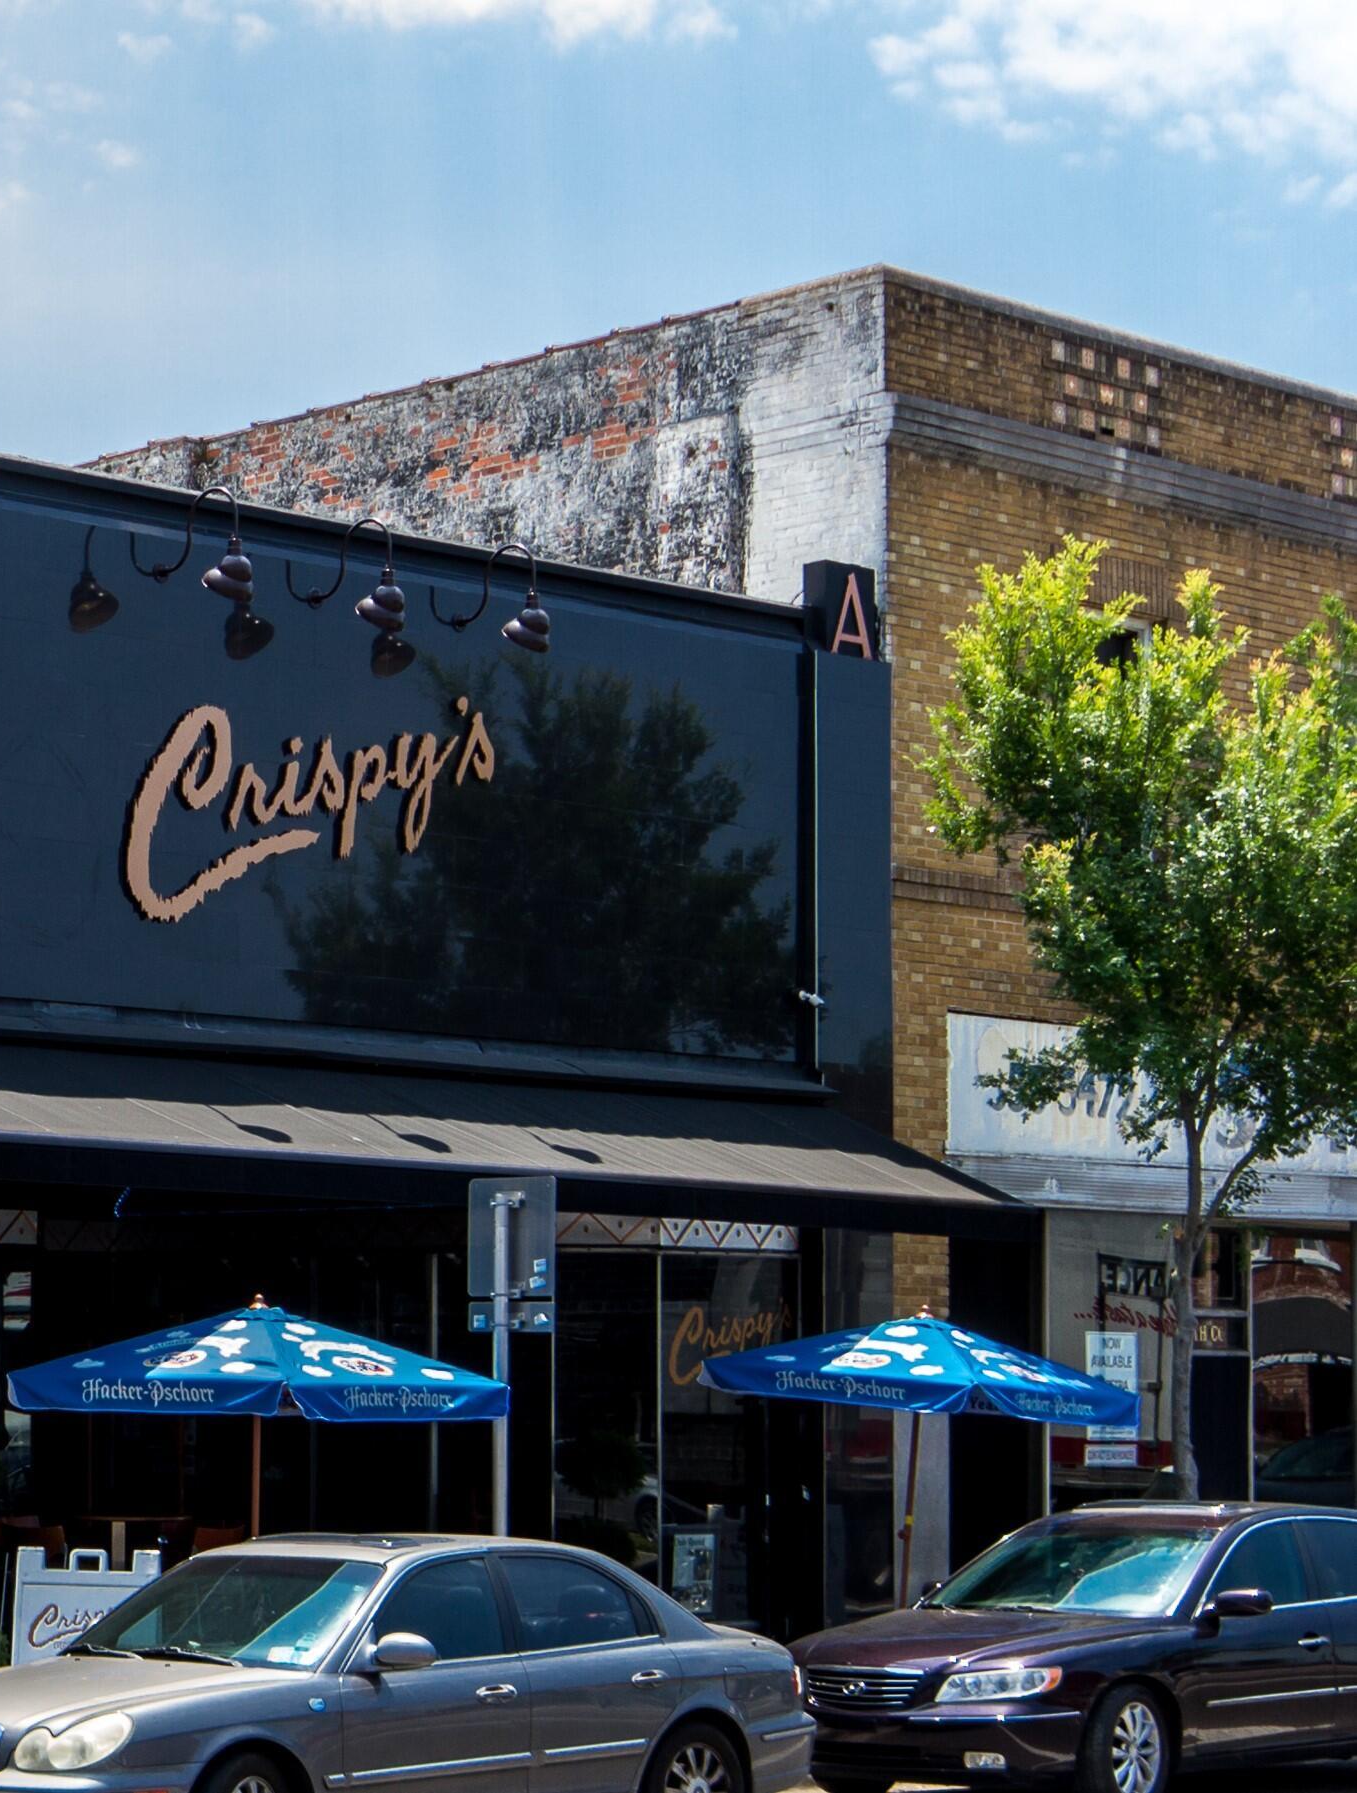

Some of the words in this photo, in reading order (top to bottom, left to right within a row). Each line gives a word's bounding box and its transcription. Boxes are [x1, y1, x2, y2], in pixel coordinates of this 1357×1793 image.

[830, 572, 873, 660] A
[121, 695, 495, 923] Crispy's
[668, 1298, 793, 1386] Crispy's
[1102, 1337, 1122, 1350] NOW
[1090, 1355, 1133, 1369] AVAILABLE
[81, 1378, 216, 1408] Hacker-Pschorr
[343, 1385, 455, 1411] Hacker-Pschorr
[774, 1370, 907, 1401] Hacker-Pschorr
